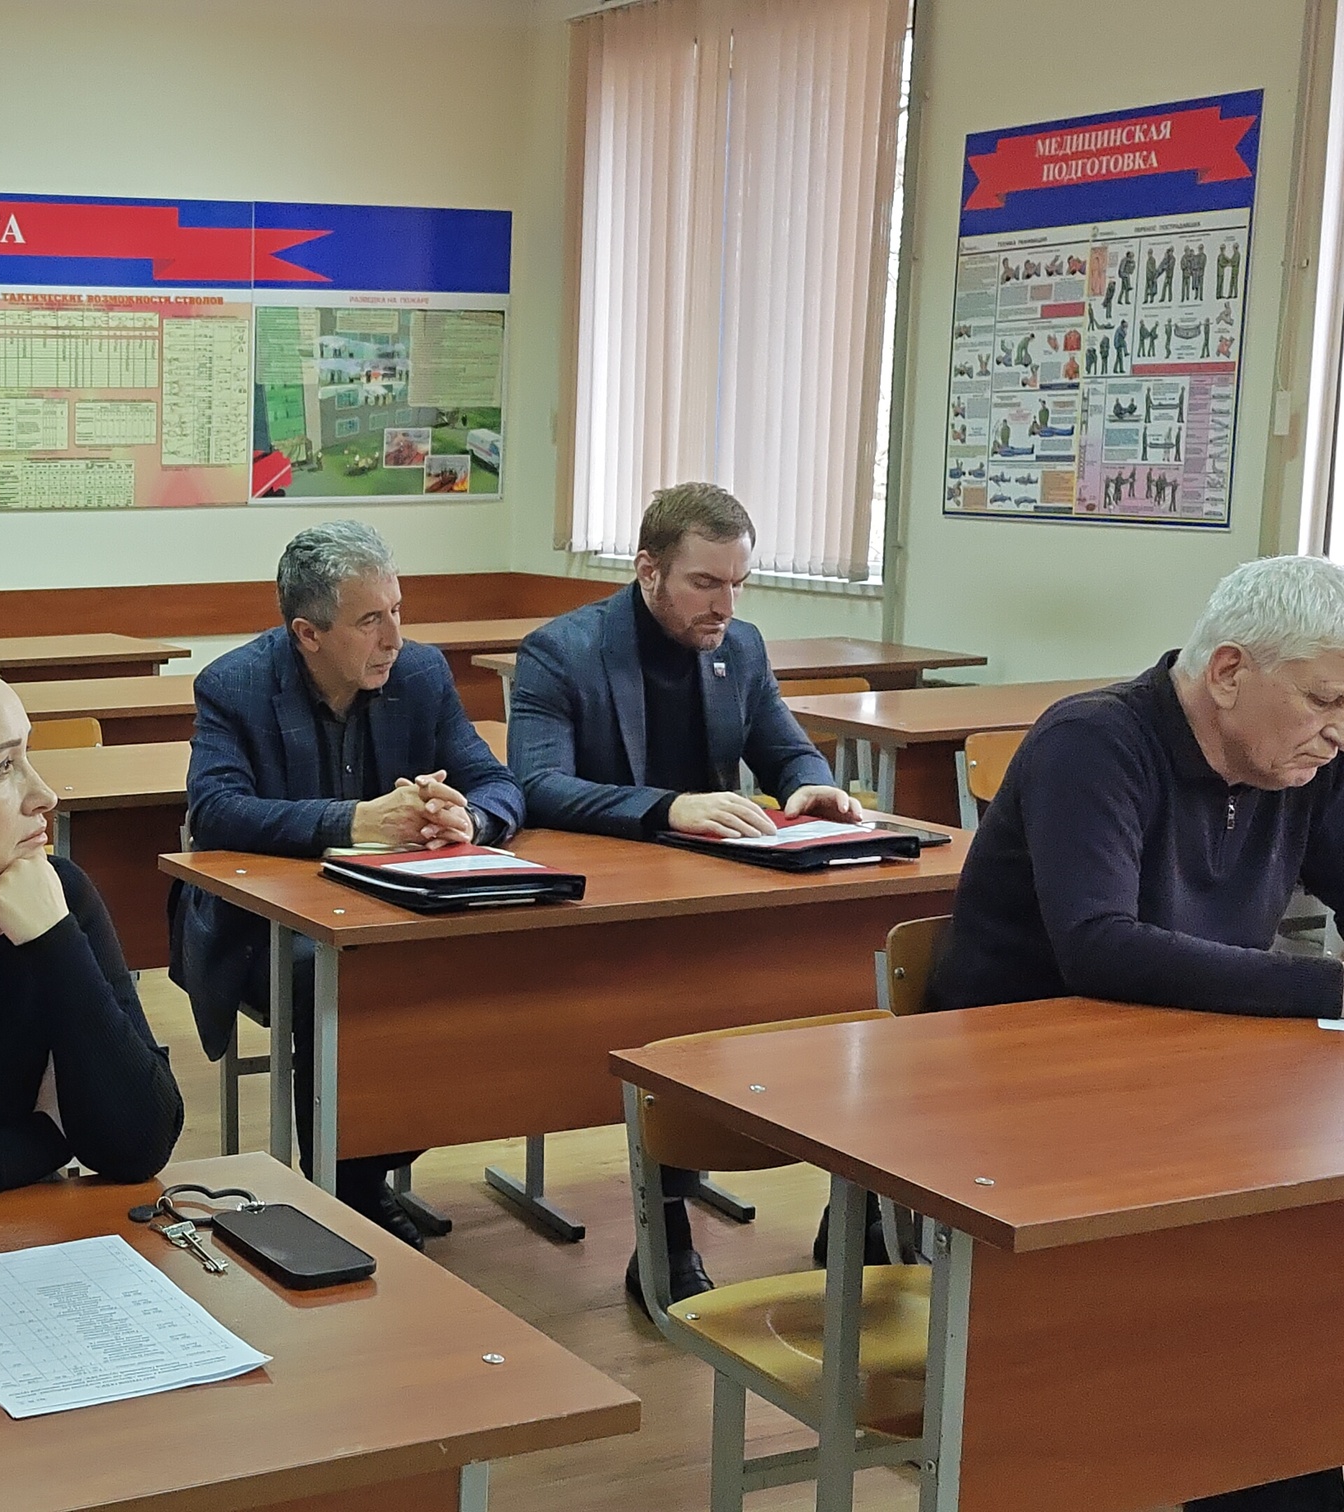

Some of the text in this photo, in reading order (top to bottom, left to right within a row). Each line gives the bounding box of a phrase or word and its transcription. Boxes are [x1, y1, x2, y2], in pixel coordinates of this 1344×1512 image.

[1035, 120, 1172, 157] МЕДИЦИНСКАЯ
[1041, 150, 1158, 182] ПОДГОТОВКА
[1, 292, 224, 306] ТАКТИЧЕСКИЕ ВОЗМОЖНОСТИ СТВОЛОВ
